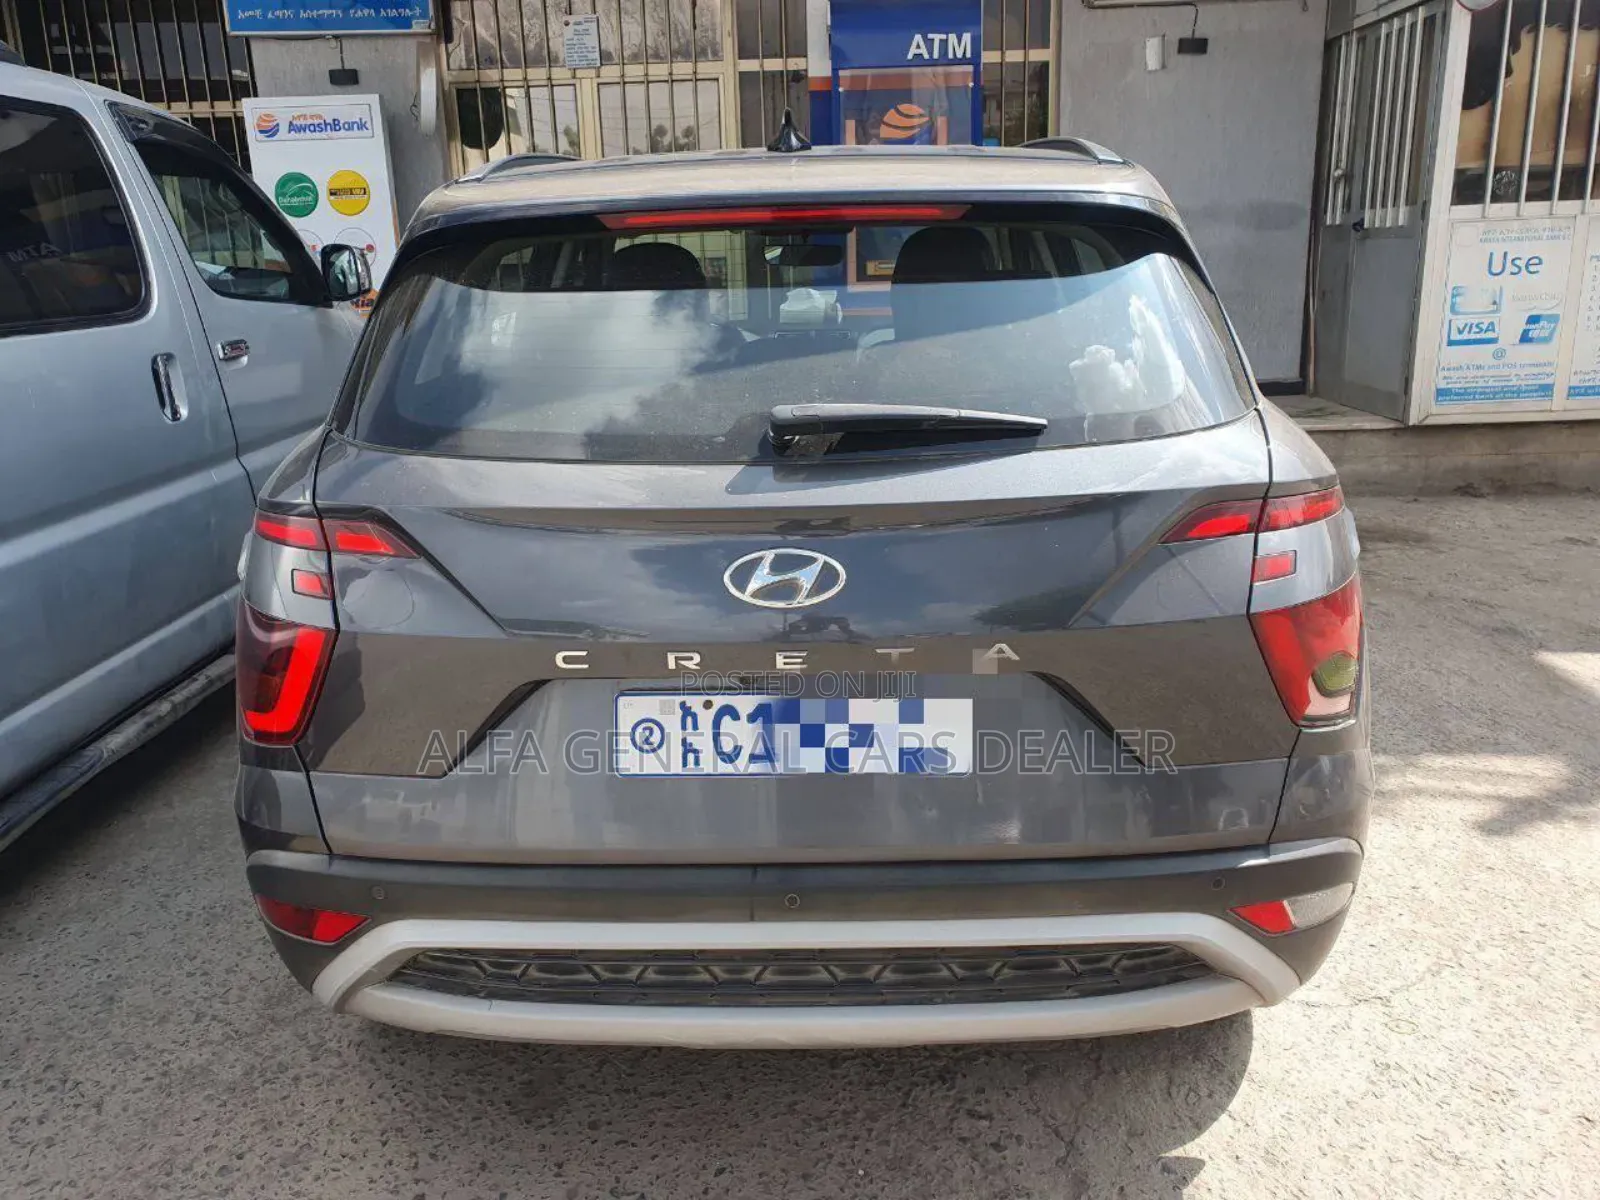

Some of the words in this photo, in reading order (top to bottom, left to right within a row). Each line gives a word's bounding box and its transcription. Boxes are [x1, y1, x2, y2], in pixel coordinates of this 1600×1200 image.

[907, 32, 971, 60] ATM
[1487, 250, 1543, 277] Use
[1456, 320, 1496, 335] VISA
[555, 643, 1021, 670] CRETA
